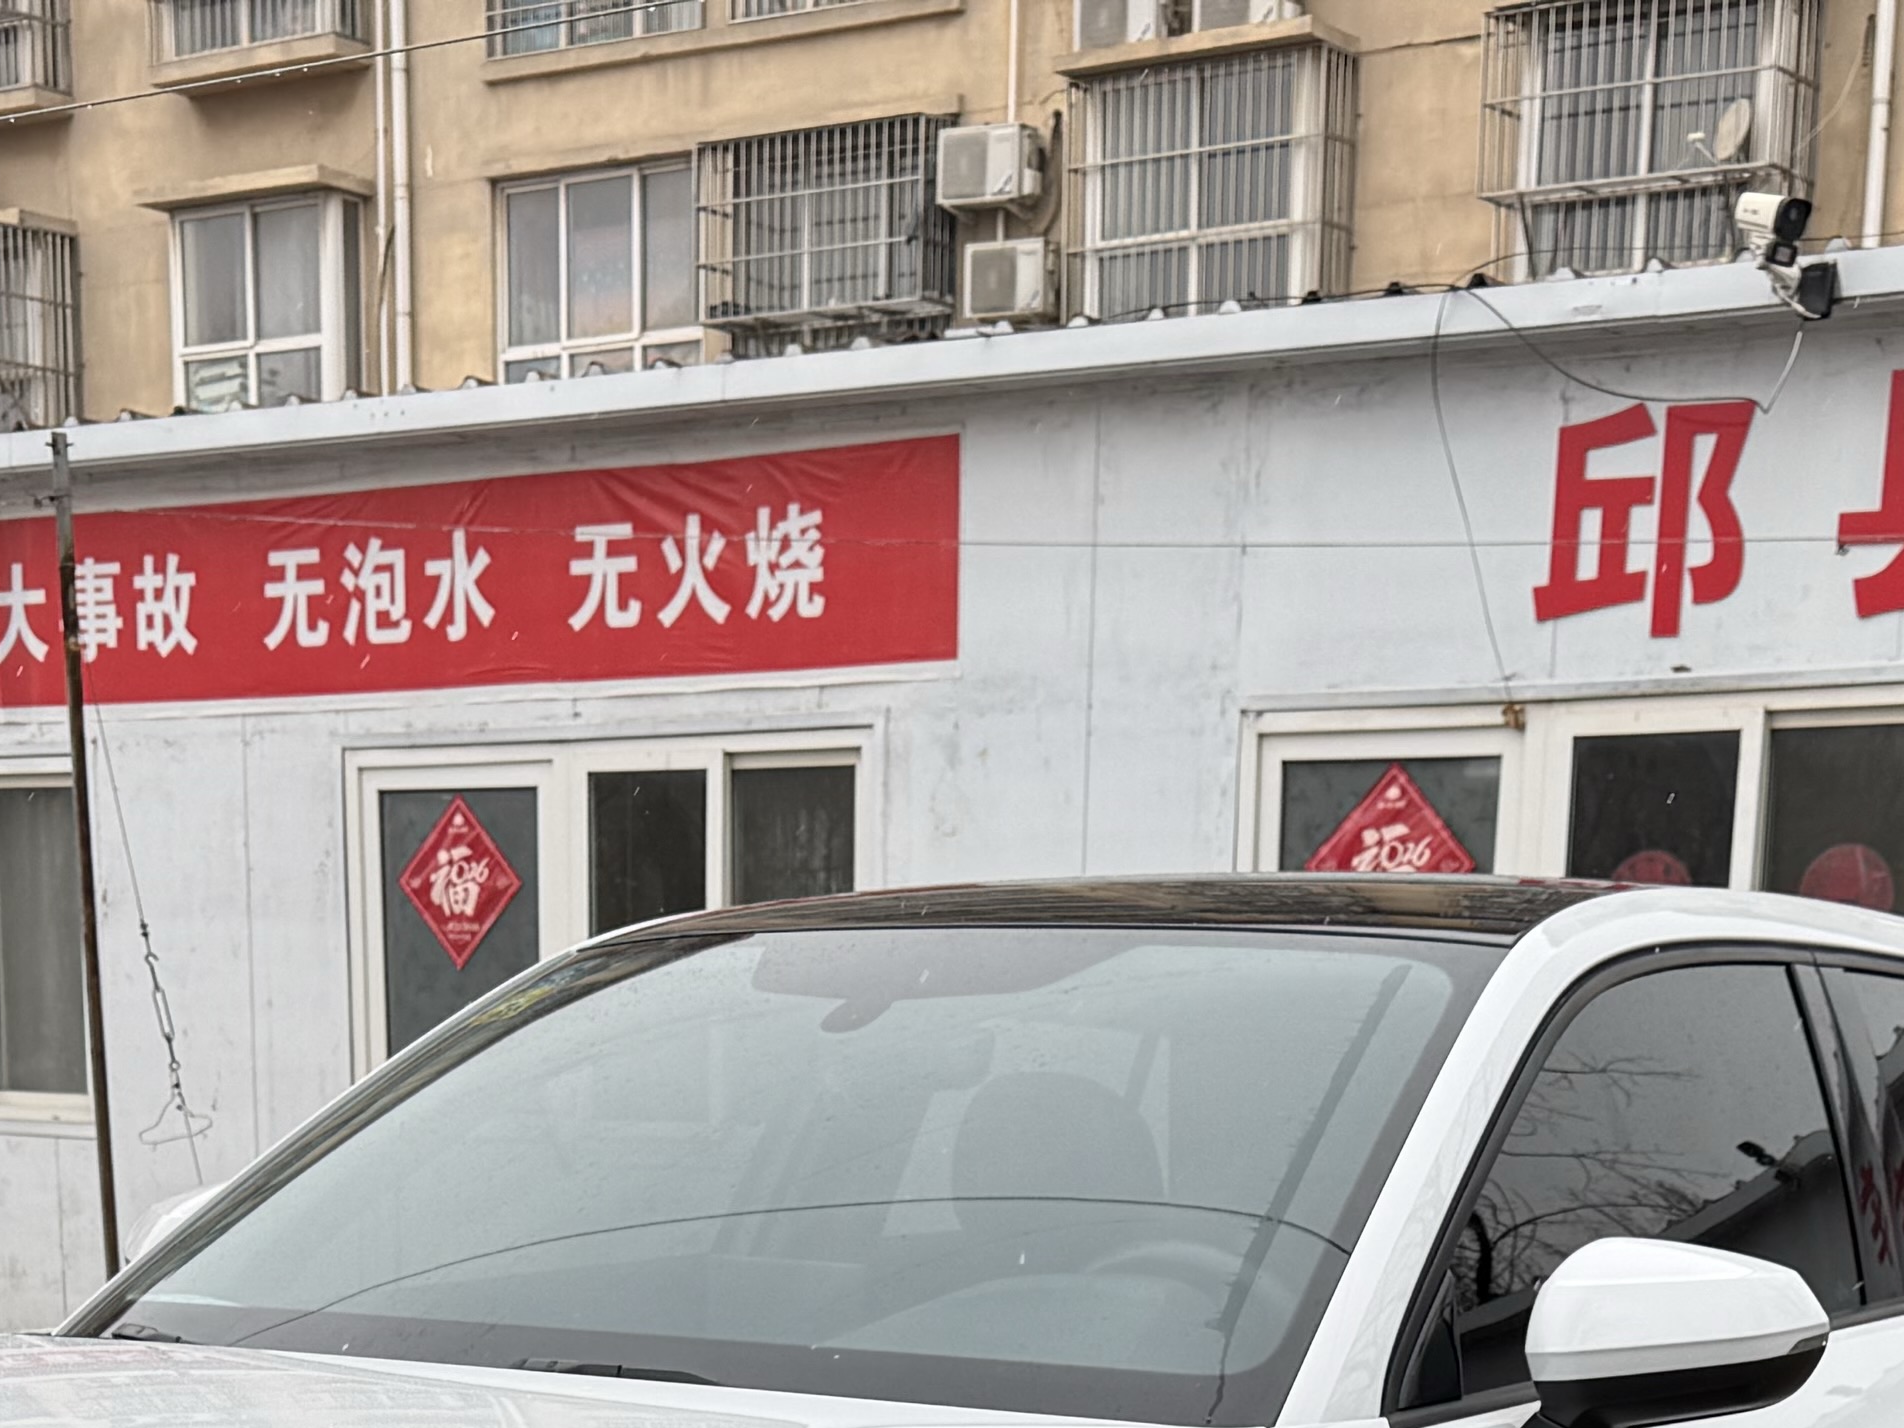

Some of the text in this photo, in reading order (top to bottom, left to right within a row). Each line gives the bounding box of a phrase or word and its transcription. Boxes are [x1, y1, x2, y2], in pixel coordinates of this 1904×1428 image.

[262, 528, 496, 650] 无泡水
[568, 502, 826, 633] 无火烧
